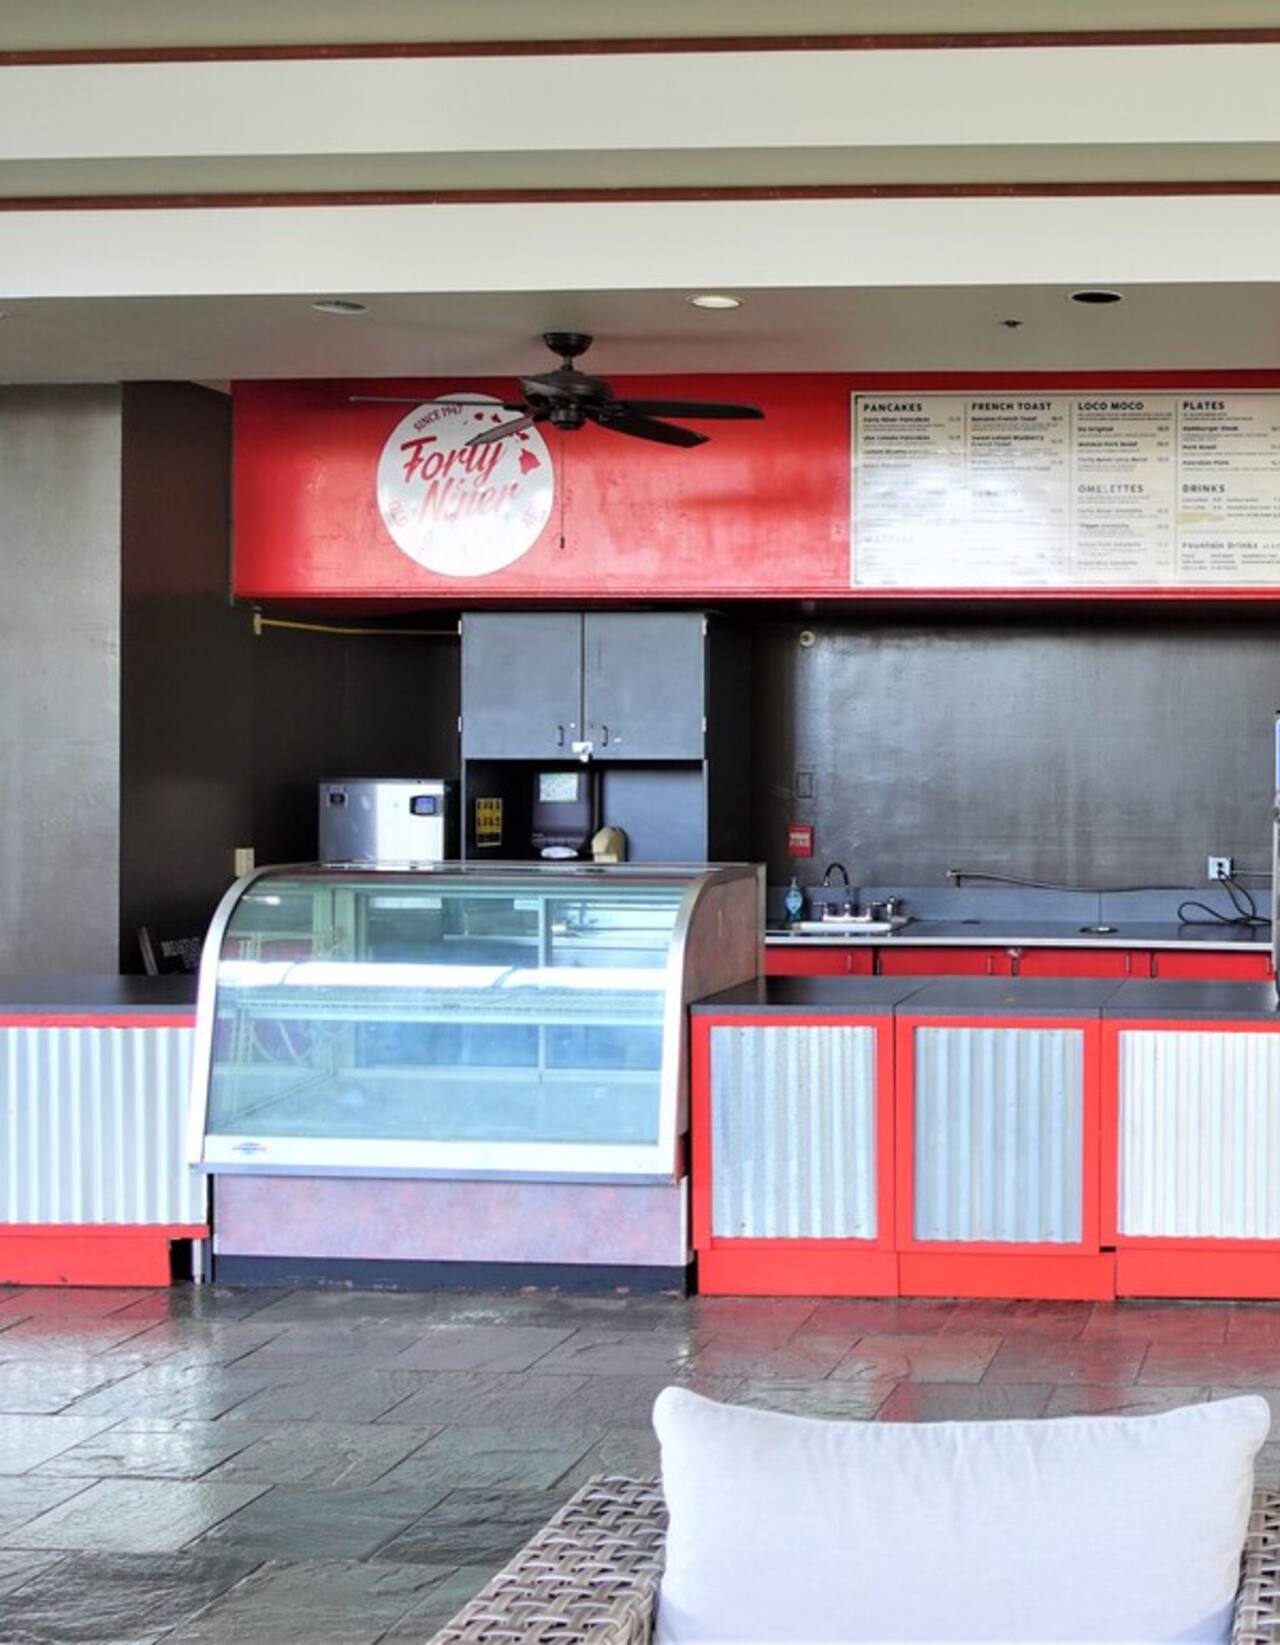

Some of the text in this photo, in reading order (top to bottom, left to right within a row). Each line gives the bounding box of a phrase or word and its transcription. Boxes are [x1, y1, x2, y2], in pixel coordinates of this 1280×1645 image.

[863, 403, 922, 412] PANCAKES
[971, 402, 1052, 411] FRENCH TOAST
[1078, 401, 1145, 410] LOCO MOCO
[1183, 401, 1225, 410] PLATES
[413, 404, 465, 432] SINCE 1947
[401, 436, 507, 487] Forty
[1078, 484, 1144, 493] OMELETTES
[1182, 484, 1225, 493] DRINKS
[419, 477, 522, 522] Niner
